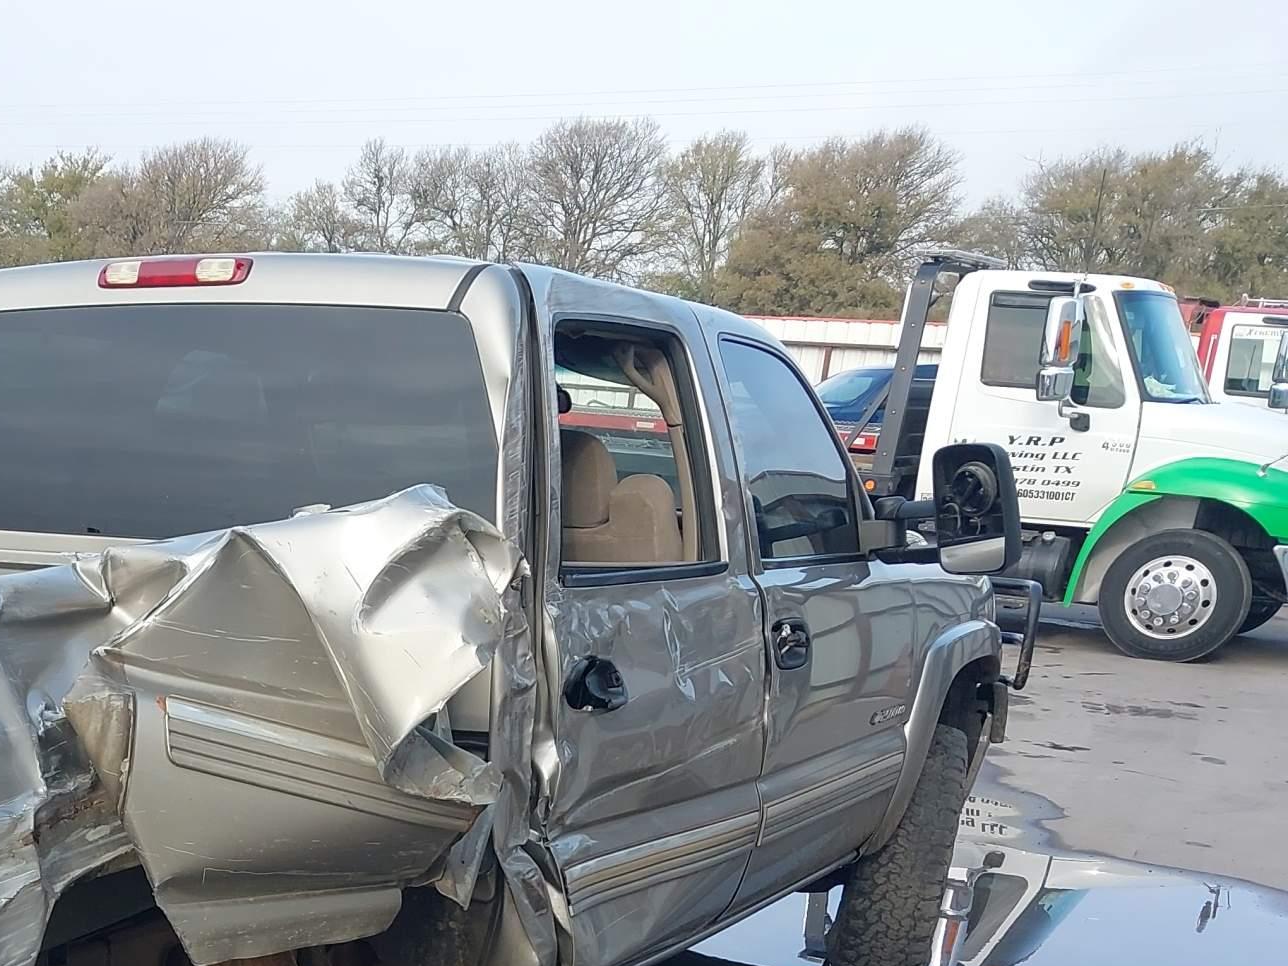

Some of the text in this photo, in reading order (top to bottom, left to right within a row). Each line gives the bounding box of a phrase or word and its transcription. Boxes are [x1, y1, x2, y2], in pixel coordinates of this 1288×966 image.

[1008, 435, 1066, 447] Y.R.P
[1008, 450, 1083, 461] wing LLC
[1011, 464, 1075, 474] stin TX
[1040, 479, 1081, 488] 0499
[1016, 488, 1077, 502] 605331001CT
